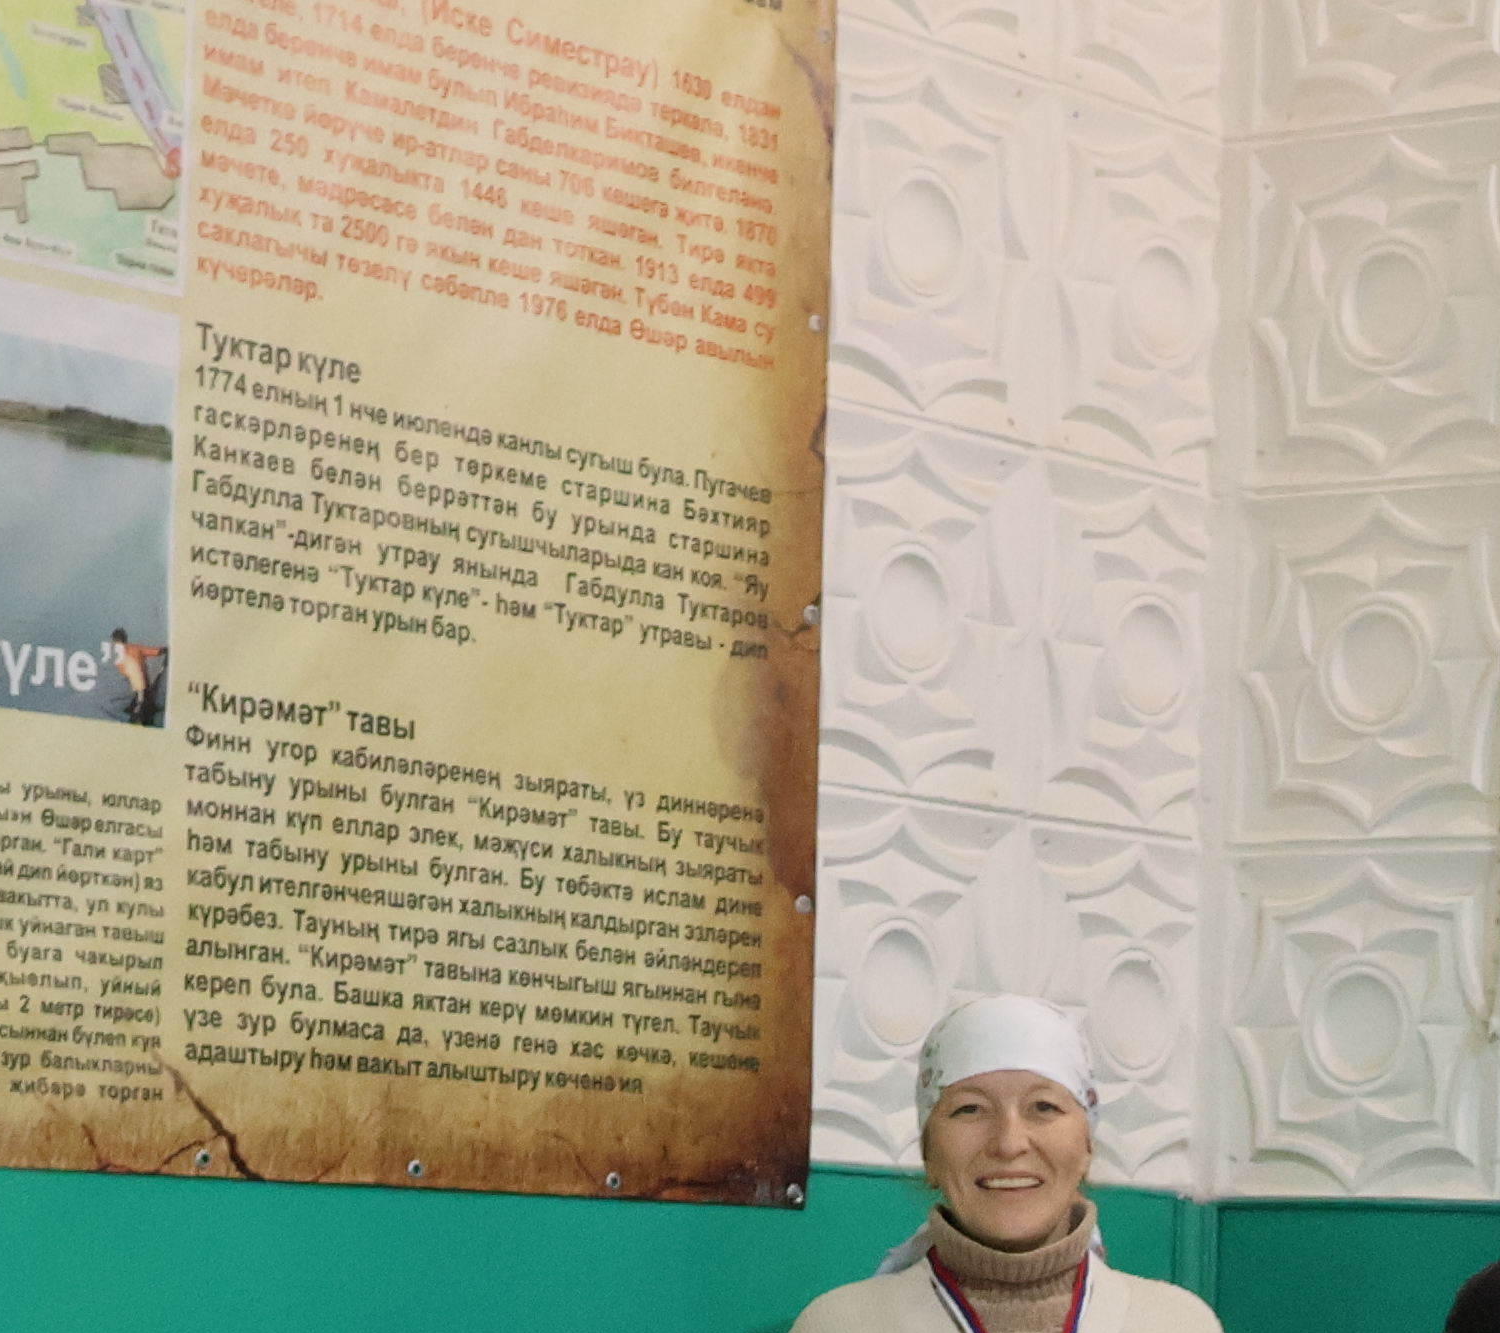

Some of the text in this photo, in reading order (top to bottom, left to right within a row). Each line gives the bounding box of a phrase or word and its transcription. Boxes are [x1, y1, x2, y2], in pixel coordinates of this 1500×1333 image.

[196, 321, 362, 384] Туктар күле
[187, 681, 416, 741] “Кирәмәт” тавы
[183, 760, 277, 798] табыну
[288, 776, 368, 804] урыны
[379, 782, 455, 815] булган
[656, 819, 684, 851] Бу
[186, 798, 276, 826] моннан
[285, 810, 323, 837] күп
[331, 815, 401, 847] еллар
[561, 844, 668, 878] халыкның
[186, 827, 233, 855] һәм
[244, 836, 330, 873] табыну
[340, 852, 419, 877] урыны
[519, 866, 547, 898] Бу
[554, 873, 634, 903] төбәктә
[642, 887, 706, 911] ислам
[187, 902, 284, 931] күрәбез.
[293, 907, 381, 944] Тауның
[387, 923, 440, 950] тирә
[445, 929, 486, 951] ягы
[492, 934, 569, 960] сазлык
[574, 938, 637, 966] белән
[184, 937, 291, 965] алынган.
[423, 959, 503, 986] тавына
[507, 968, 617, 997] көнчыгыш
[622, 980, 708, 1005] ягыннан
